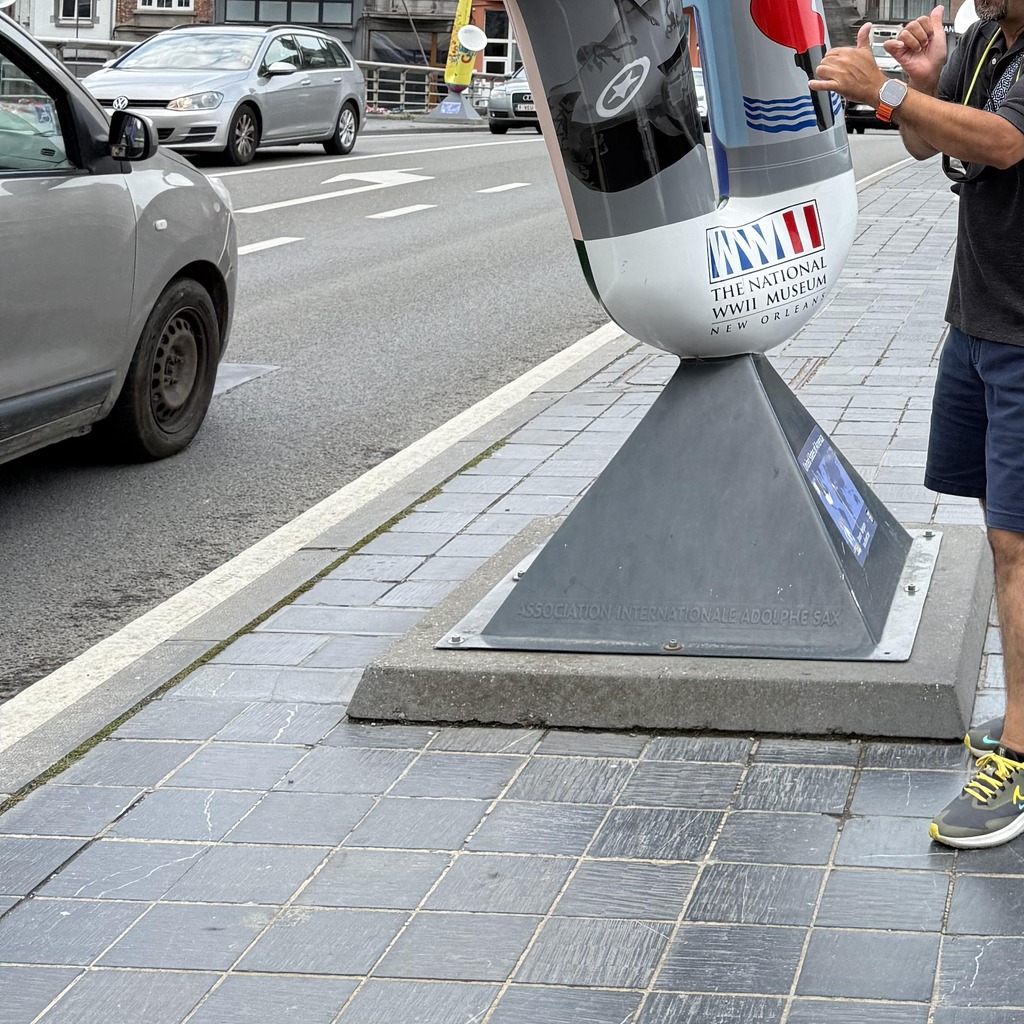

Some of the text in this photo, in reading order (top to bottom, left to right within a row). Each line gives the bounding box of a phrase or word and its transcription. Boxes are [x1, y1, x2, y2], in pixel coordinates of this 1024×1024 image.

[711, 256, 828, 302] THE NATIONAL
[712, 274, 827, 320] WWII MUSEUM
[710, 293, 826, 336] NEW ORLEANS
[518, 601, 841, 627] ASSOCIATION INTERNATIONALE ADOLPHE SAX
